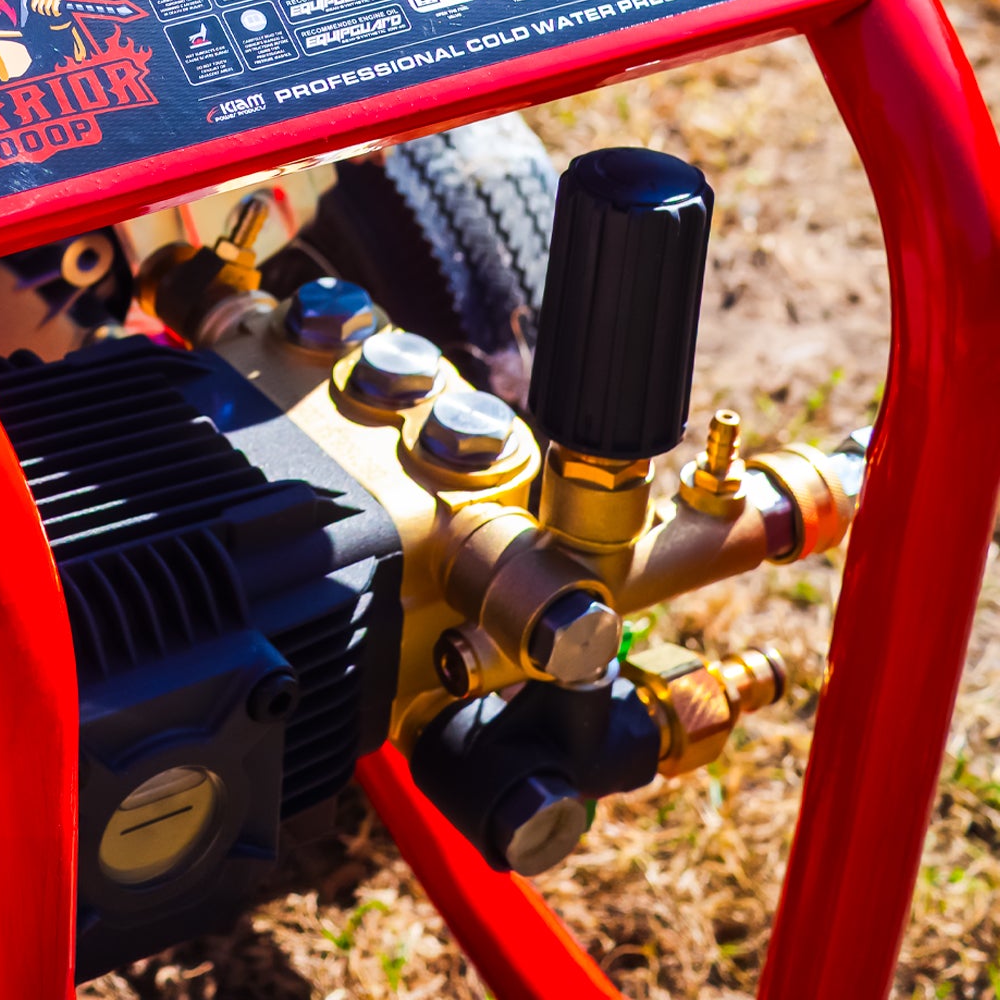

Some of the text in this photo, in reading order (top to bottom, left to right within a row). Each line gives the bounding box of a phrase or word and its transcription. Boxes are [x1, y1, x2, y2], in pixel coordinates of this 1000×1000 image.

[273, 44, 465, 104] PROFESSIONAL
[465, 26, 531, 53] COLD
[530, 3, 616, 36] WATER
[301, 18, 357, 38] RECOMMENDED
[359, 11, 385, 22] ENGINE
